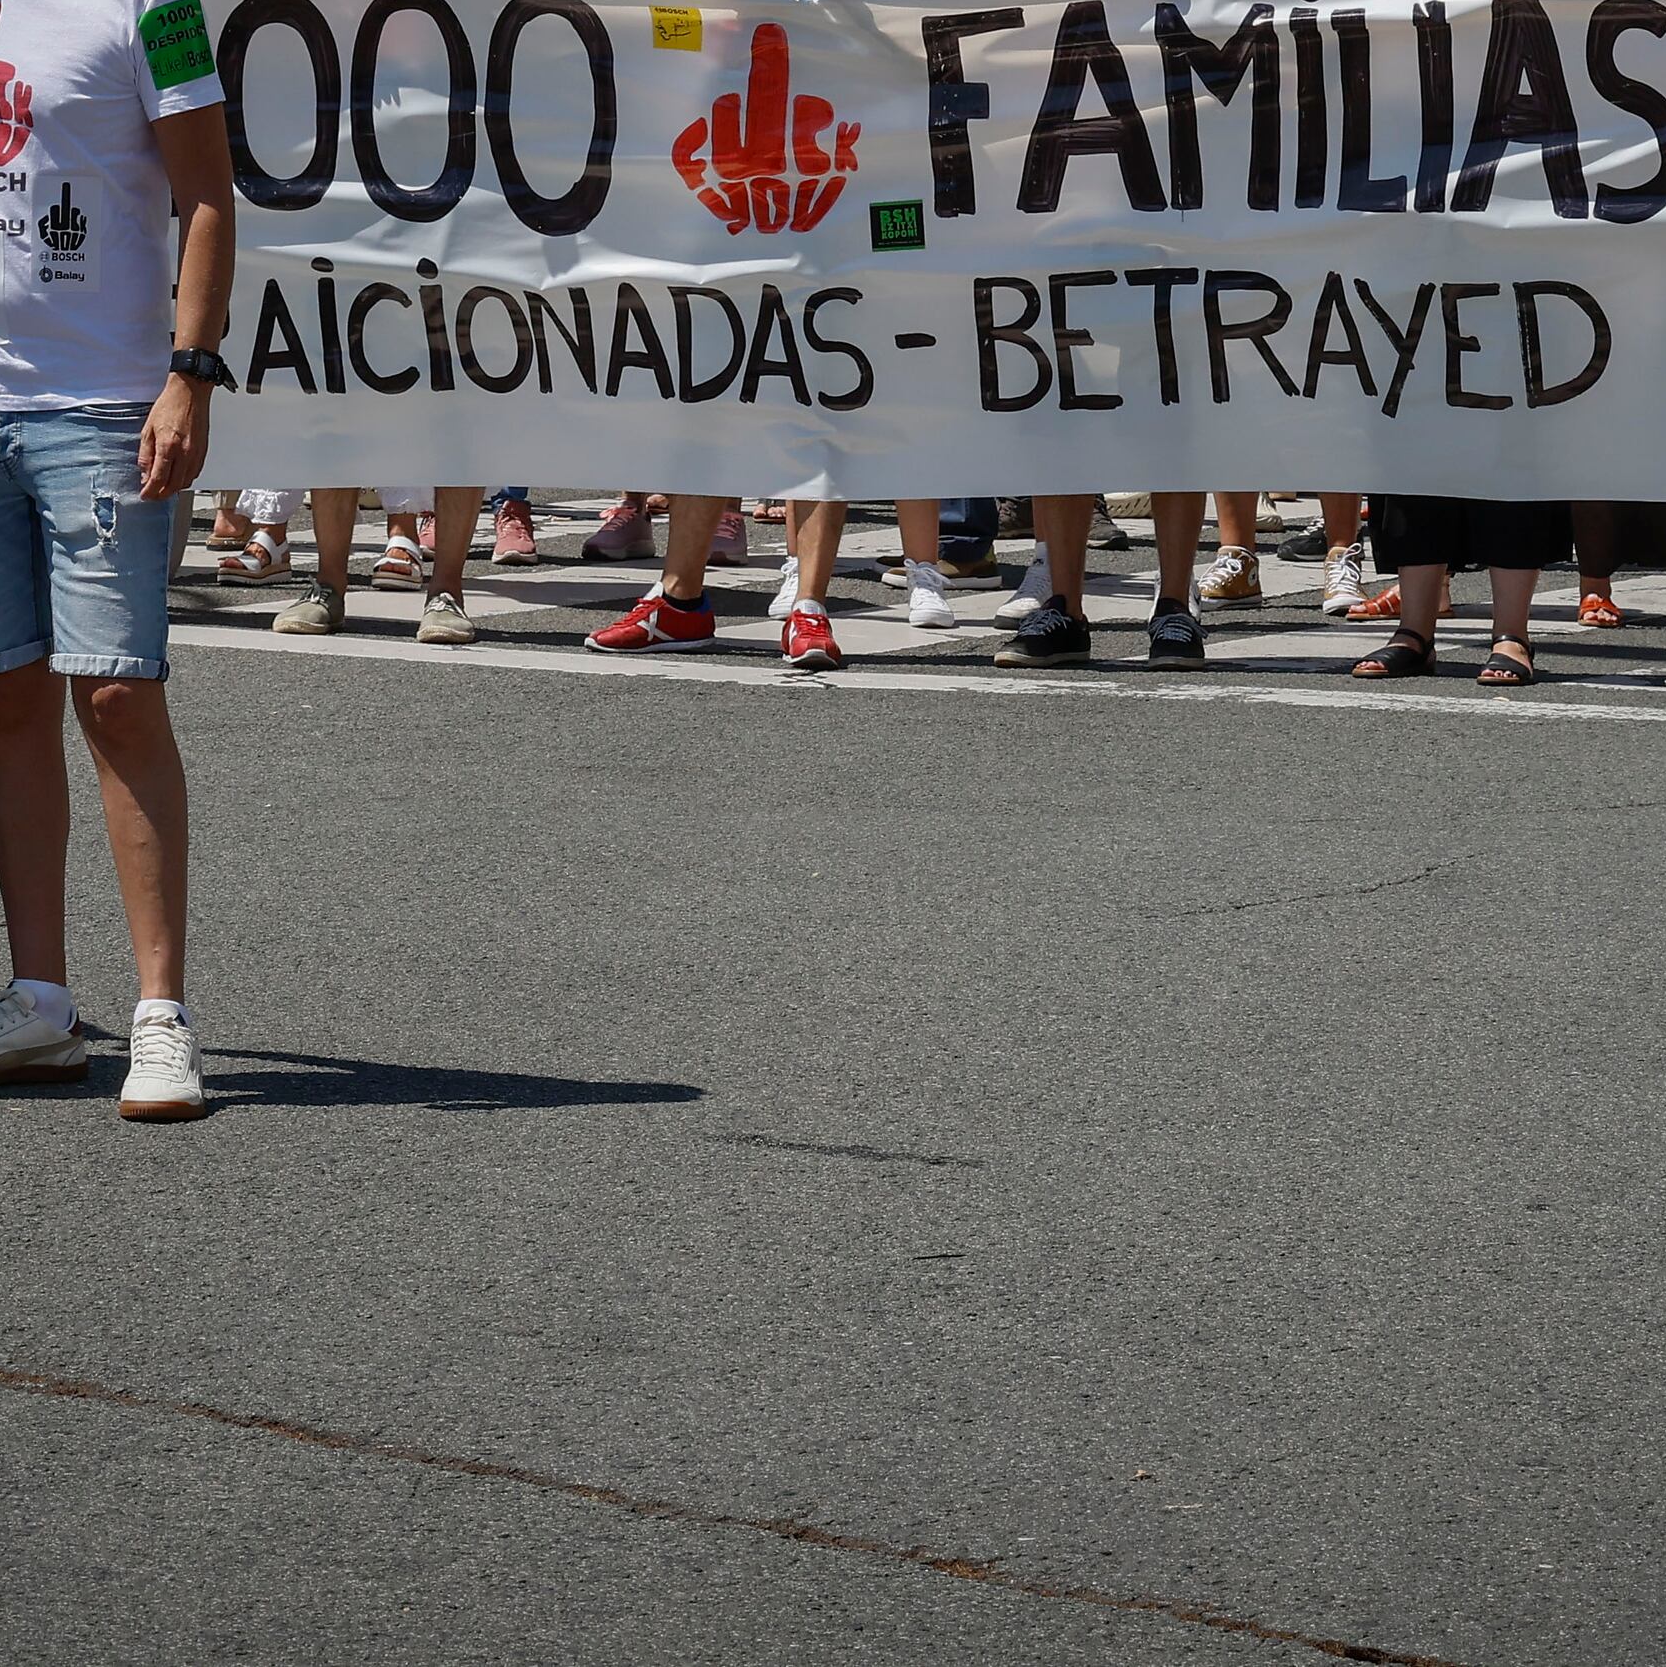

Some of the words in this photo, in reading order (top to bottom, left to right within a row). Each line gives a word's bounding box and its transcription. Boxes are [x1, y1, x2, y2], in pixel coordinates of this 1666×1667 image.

[157, 4, 194, 27] 1000
[671, 23, 861, 190] FUCK
[37, 182, 87, 240] FUCK
[697, 175, 847, 236] YOU
[880, 208, 916, 223] BSH
[43, 231, 86, 251] YOU
[51, 252, 85, 261] BOSCH
[54, 271, 85, 282] Balay
[974, 268, 1612, 419] BETRAYED
